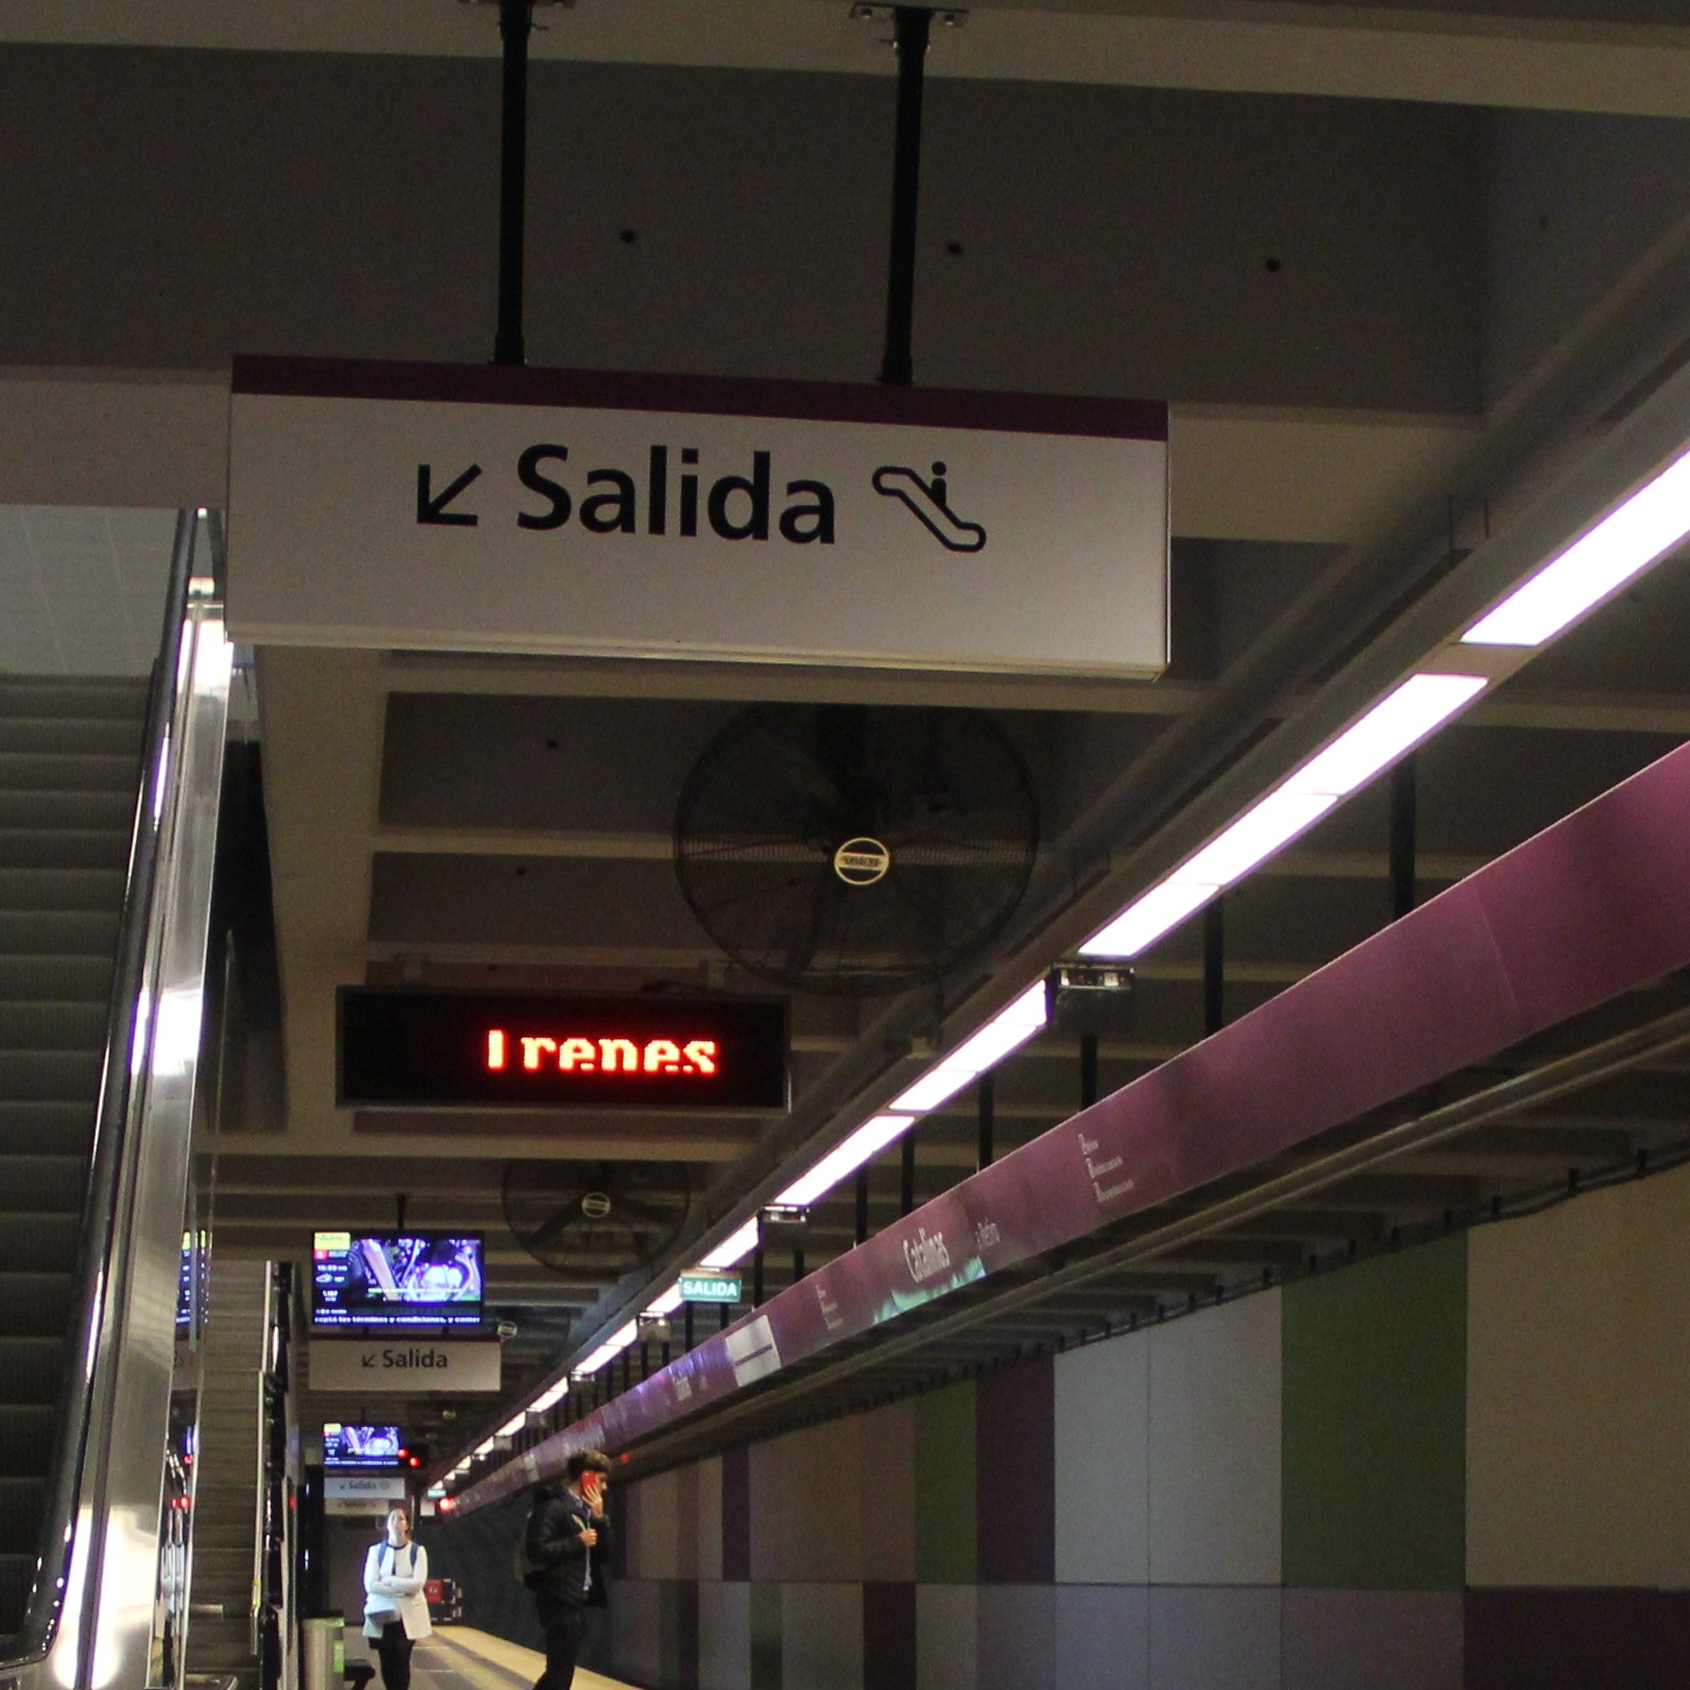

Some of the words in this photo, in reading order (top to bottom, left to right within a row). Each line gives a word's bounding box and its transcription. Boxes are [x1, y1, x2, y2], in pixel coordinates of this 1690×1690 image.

[517, 442, 836, 545] Salida
[683, 1280, 738, 1297] SALIDA
[382, 1349, 448, 1369] Salida
